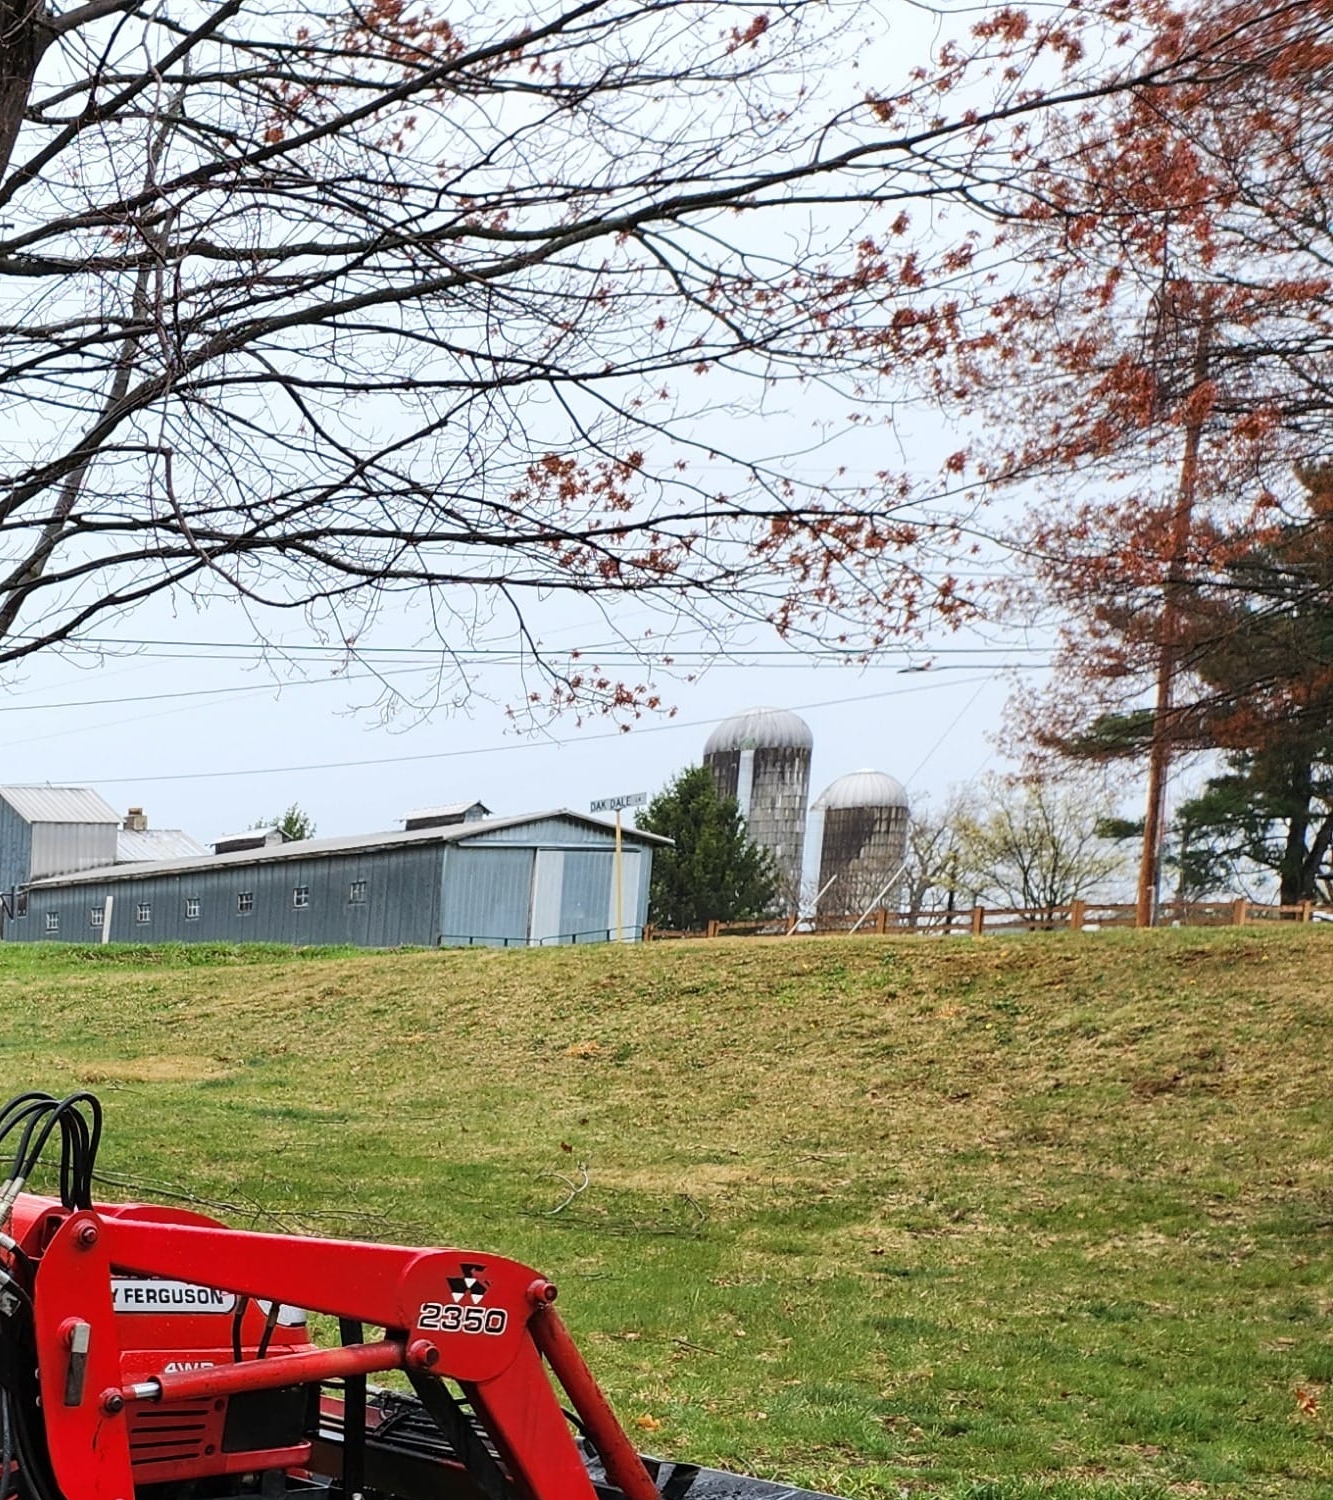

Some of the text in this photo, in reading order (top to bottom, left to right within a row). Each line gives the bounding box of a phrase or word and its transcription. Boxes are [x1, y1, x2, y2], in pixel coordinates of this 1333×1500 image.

[610, 796, 631, 808] DALE
[124, 1287, 223, 1305] FERGUSON
[417, 1303, 508, 1336] 2350
